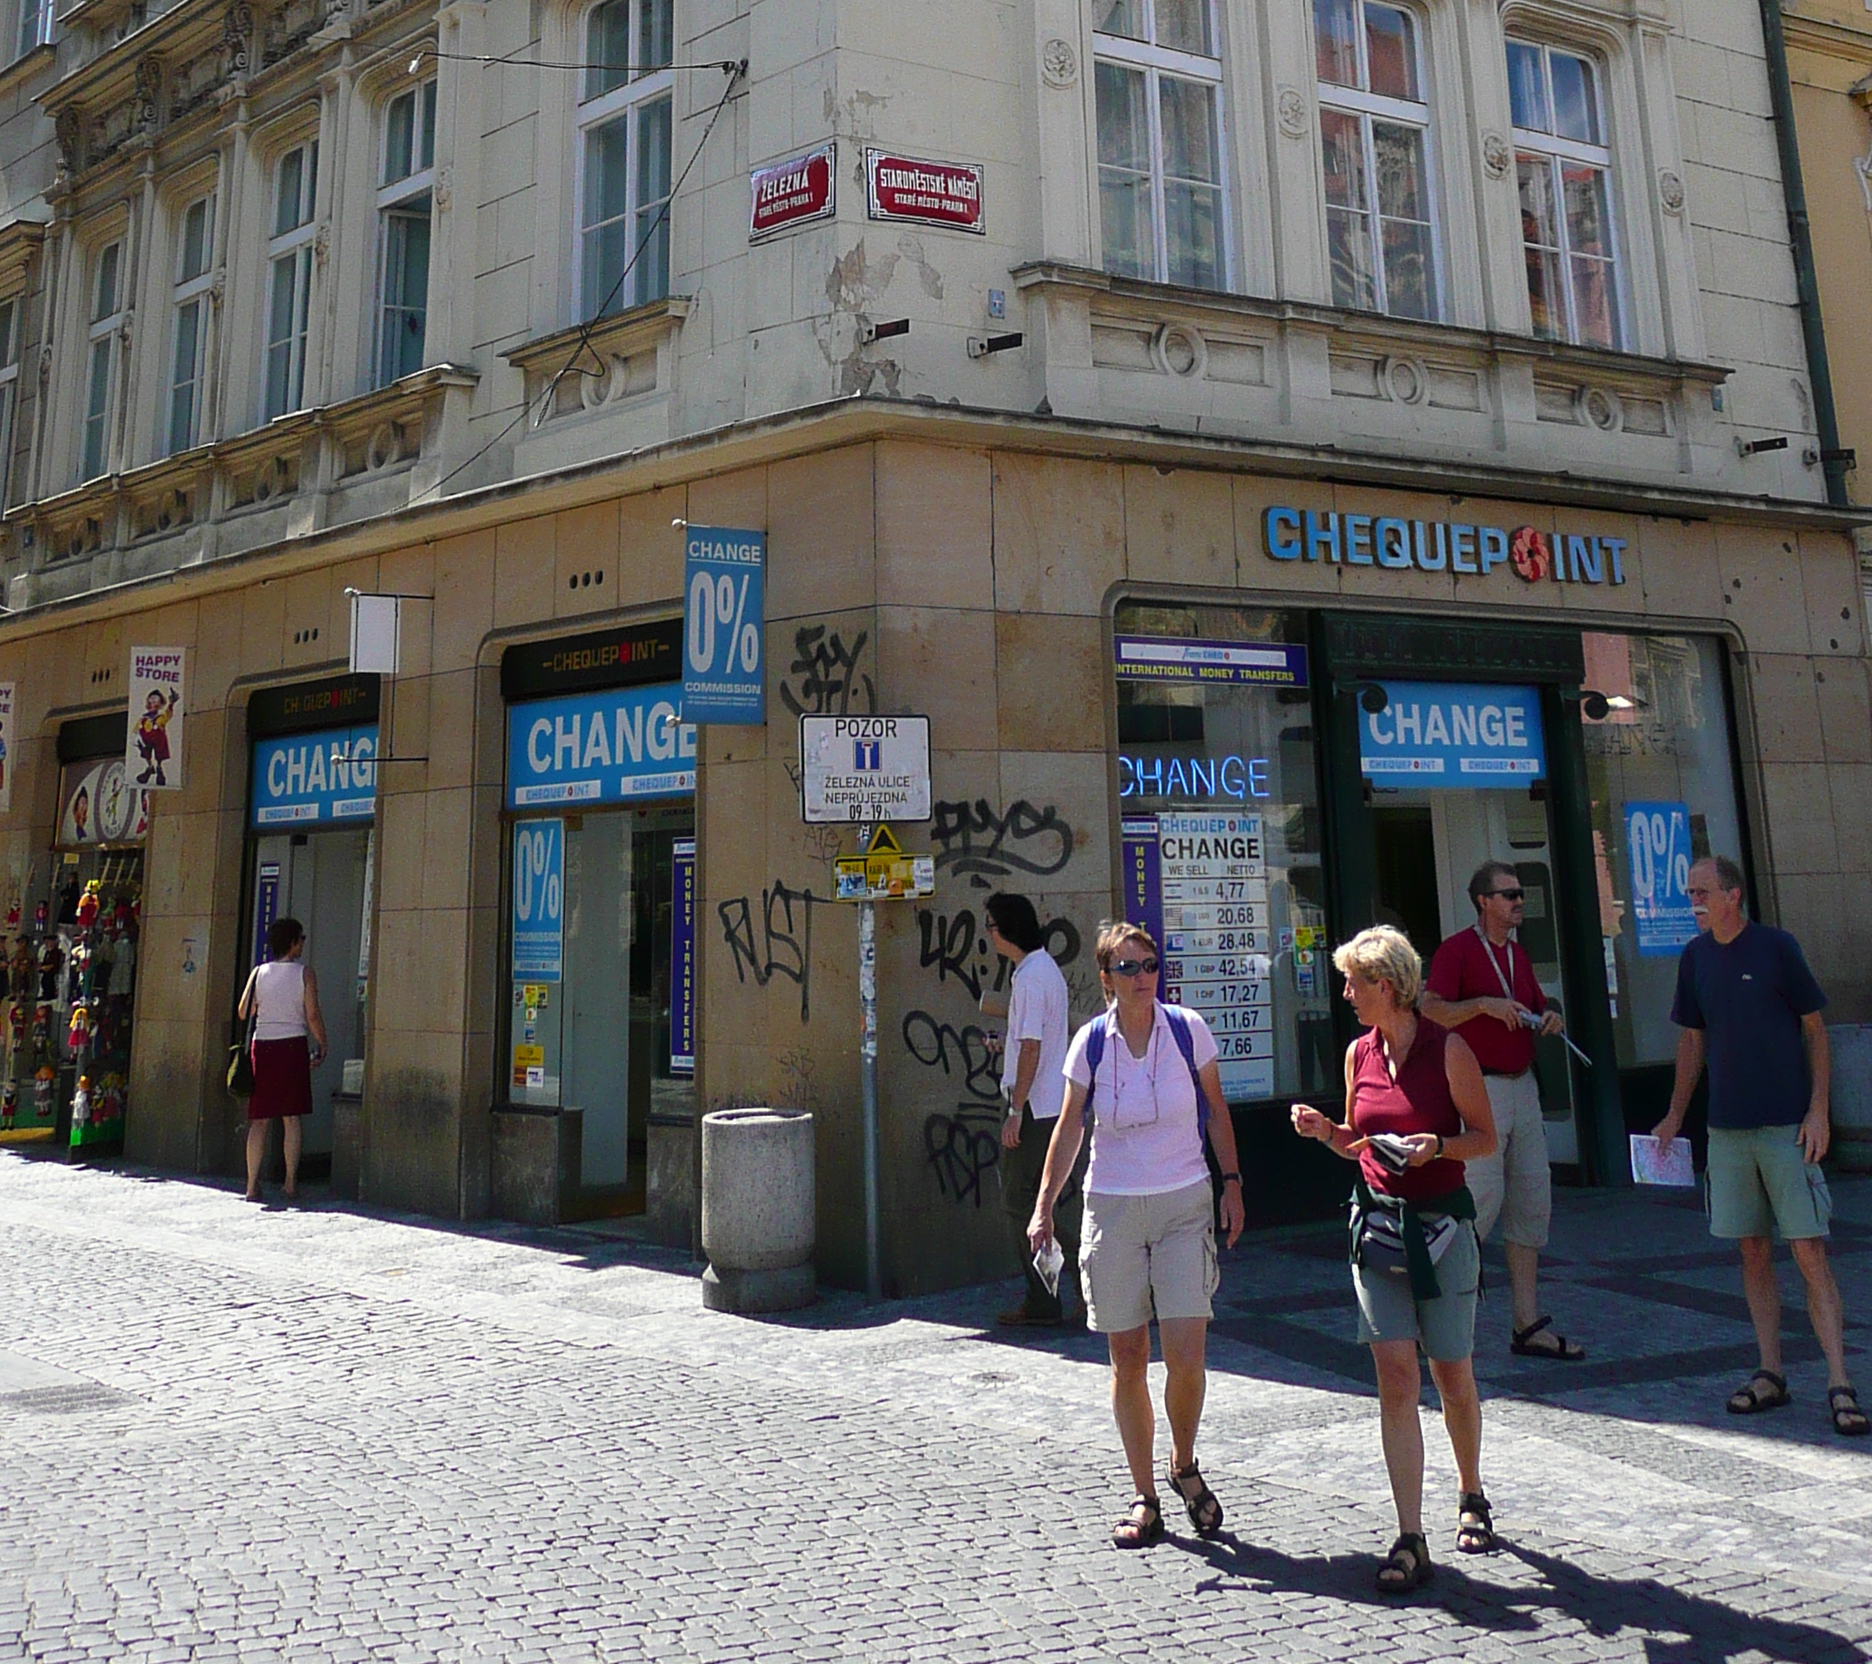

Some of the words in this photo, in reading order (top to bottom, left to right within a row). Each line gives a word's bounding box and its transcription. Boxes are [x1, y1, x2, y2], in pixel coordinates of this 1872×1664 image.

[761, 166, 809, 202] ŽELEZNÁ
[880, 168, 946, 194] STAROMĚSTSKÉ
[947, 175, 977, 200] NÁMĚSTÍ
[894, 193, 916, 205] STARÉ
[689, 541, 761, 562] CHANGE
[1263, 506, 1627, 584] CHEQUEPOINT
[689, 571, 759, 673] 0%
[136, 655, 181, 667] HAPPY
[135, 667, 181, 682] STORE
[1117, 664, 1194, 677] NTERNATIONAL
[1200, 668, 1234, 679] MONEY
[1240, 669, 1295, 681] TRANSFERS
[685, 682, 760, 694] COMMISSION
[835, 719, 897, 738] POZOR
[1369, 704, 1528, 747] CHANGE
[633, 775, 695, 791] CHEQUEPOIN
[825, 774, 875, 789] ŽELEZNÁ
[878, 776, 910, 787] ULICE
[1118, 756, 1270, 799] CHANGE
[1161, 819, 1258, 833] CHEQUEPOINT
[1162, 838, 1260, 860] CHANGE
[1631, 811, 1690, 897] 0%
[517, 829, 558, 921] 0%
[1135, 847, 1145, 907] MONEY
[1169, 865, 1183, 875] WE
[1186, 865, 1209, 875] SELL
[1227, 865, 1255, 875] NETTO
[683, 866, 691, 926] MONEY
[1216, 882, 1245, 901] 4,77
[1217, 907, 1254, 925] 20,68
[1198, 938, 1213, 947] EUR
[1218, 933, 1255, 951] 28,48
[1219, 959, 1256, 976] 42,54
[683, 940, 691, 1052] TRANSFERS
[1220, 985, 1259, 1003] 17,27
[1222, 1011, 1259, 1030] 11,67
[1221, 1037, 1252, 1056] 7,66
